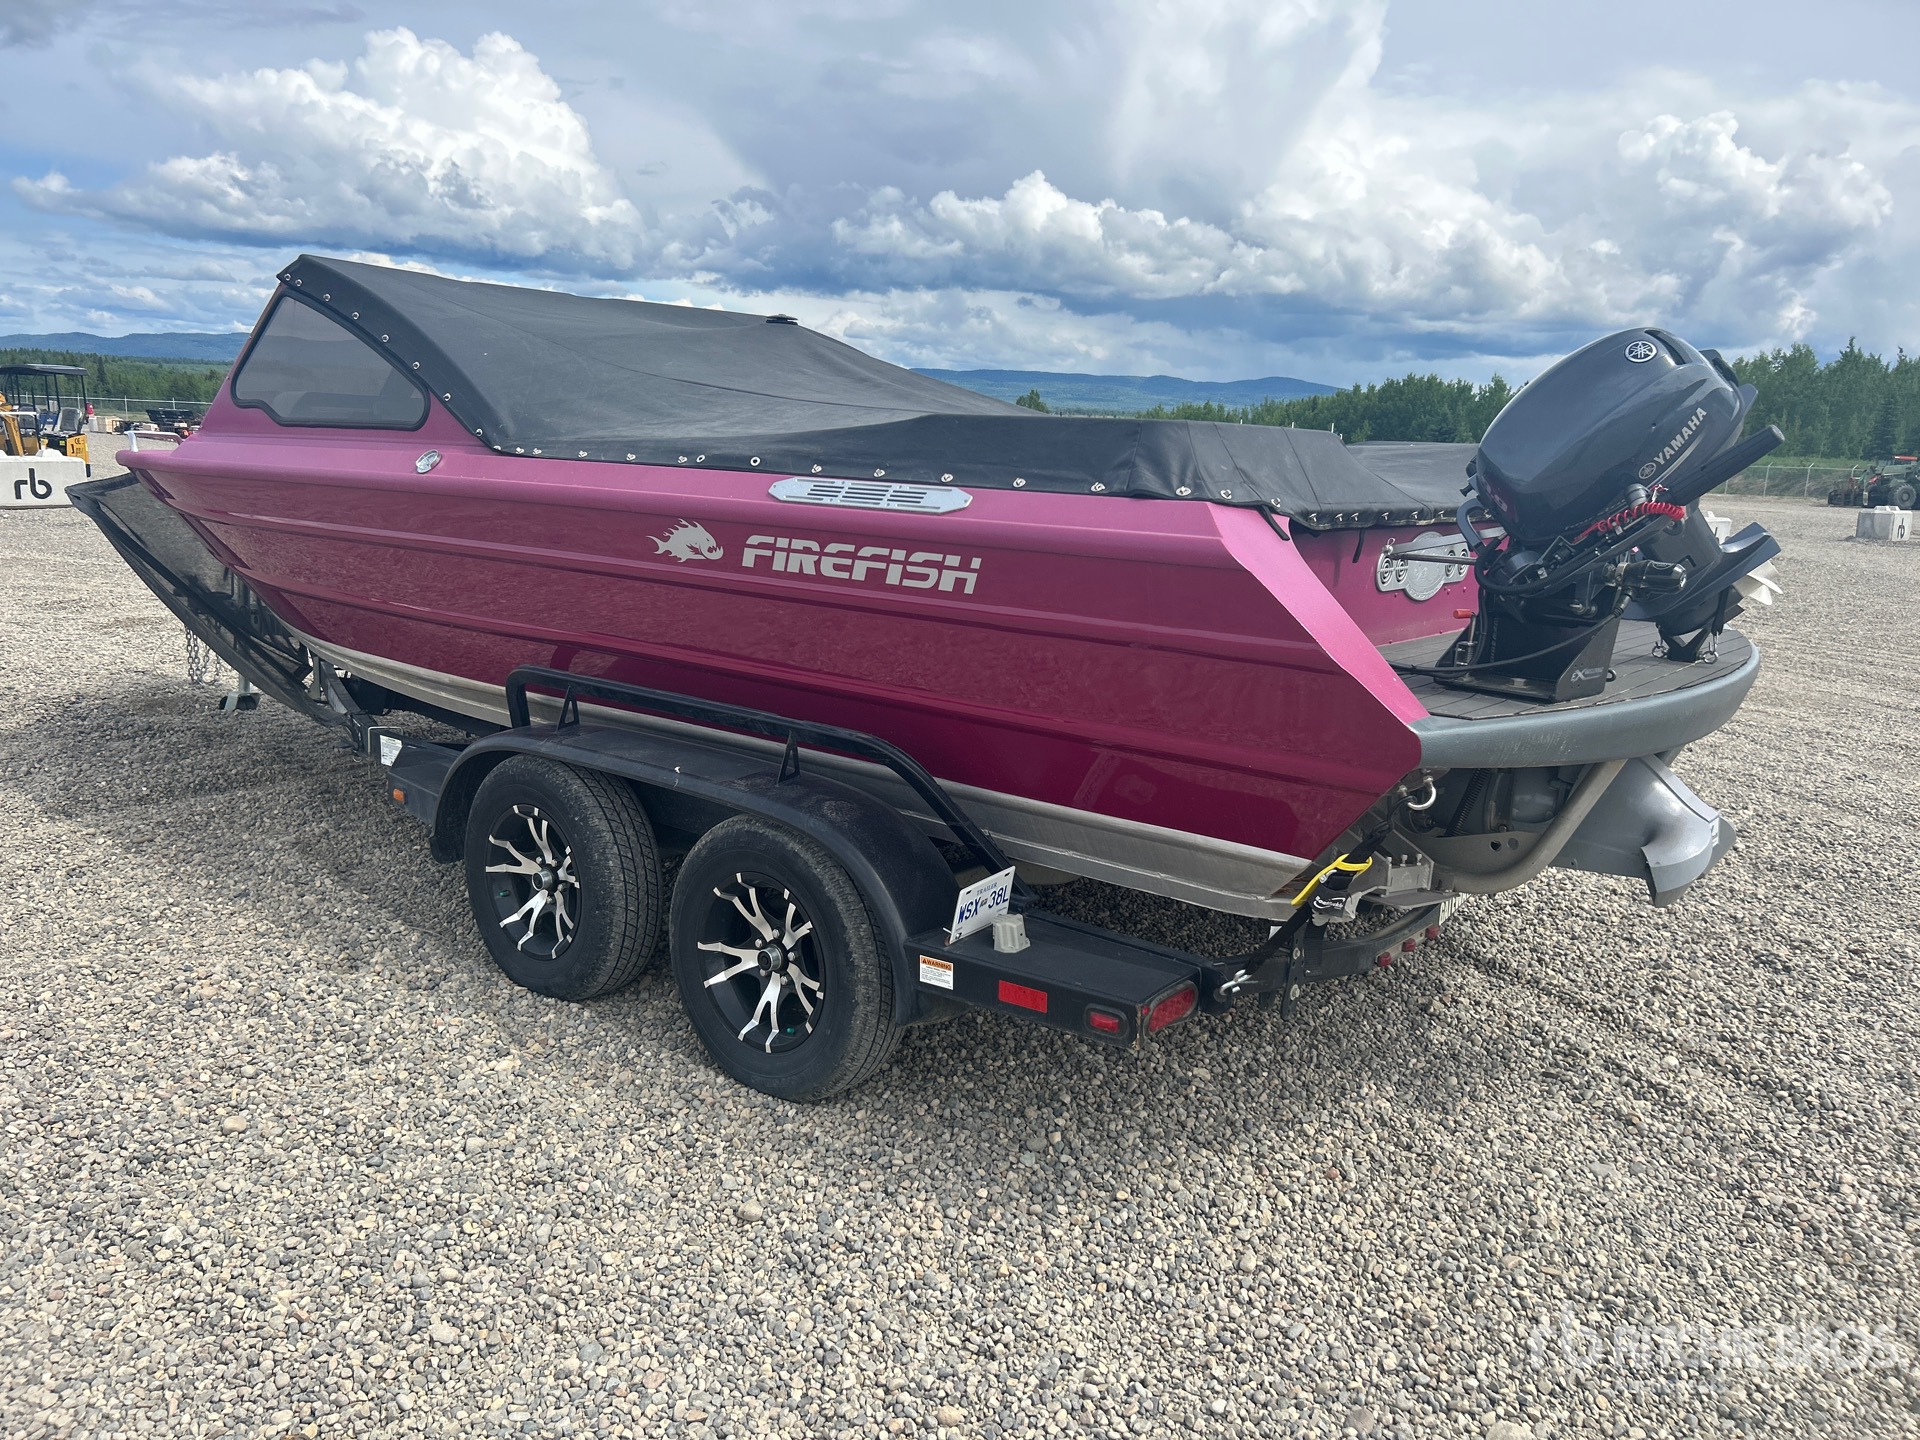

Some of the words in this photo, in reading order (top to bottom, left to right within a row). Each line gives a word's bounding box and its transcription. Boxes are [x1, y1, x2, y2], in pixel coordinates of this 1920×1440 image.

[1653, 407, 1707, 465] YAMAHA
[14, 467, 52, 499] rb
[742, 534, 982, 594] FIREFISH
[957, 896, 981, 924] WSX
[988, 884, 1009, 909] 38L
[976, 882, 998, 896] TRAILER
[926, 958, 952, 971] WARNING
